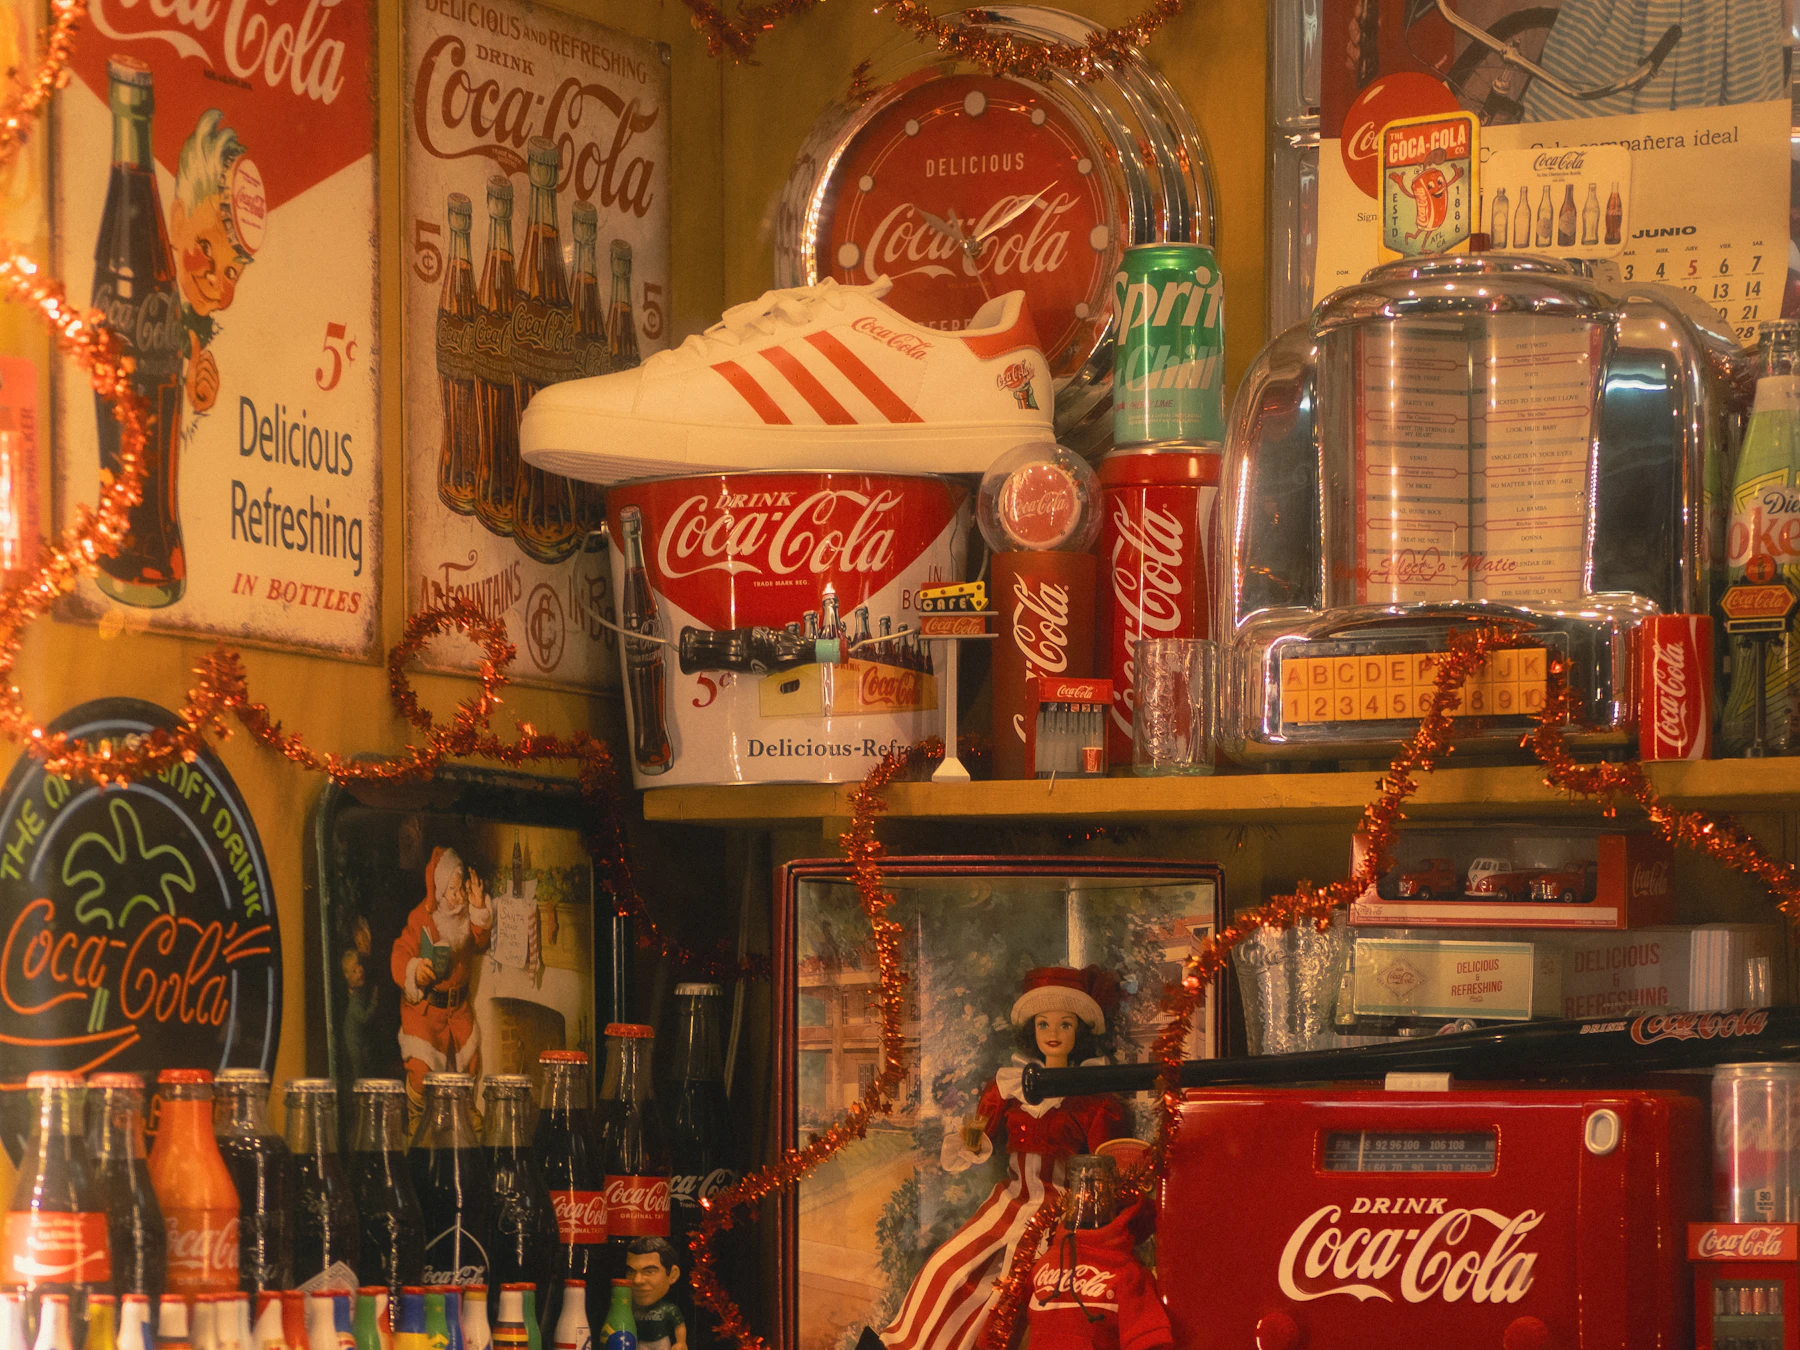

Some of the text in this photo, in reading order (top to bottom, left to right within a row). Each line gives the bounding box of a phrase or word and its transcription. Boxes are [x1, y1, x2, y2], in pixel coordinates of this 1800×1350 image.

[476, 43, 535, 77] DRINK
[523, 29, 547, 46] AND
[549, 30, 648, 85] REFRESHING
[1389, 131, 1404, 141] THE
[1389, 124, 1467, 164] COCA-COLA
[1694, 126, 1739, 147] ideal
[926, 152, 1025, 178] DELICIOUS
[1533, 150, 1586, 172] Coca-Cola
[863, 194, 1081, 281] Coca-Cola
[1632, 225, 1697, 240] JUNIO
[1624, 256, 1762, 281] 3 4 5 6 7
[1713, 281, 1761, 299] 13 14
[1741, 305, 1759, 321] 21
[850, 315, 931, 361] Coca-Cola
[239, 395, 354, 477] Delicious
[714, 491, 799, 509] DRINK
[231, 479, 363, 577] Refreshing
[658, 489, 905, 579] Coca-Cola
[231, 572, 362, 615] IN BOTTLES
[925, 616, 982, 635] Coca-Cola
[861, 666, 923, 706] Coca-Cola
[1313, 665, 1327, 685] B
[1338, 663, 1355, 683] C
[1365, 661, 1381, 681] D
[1391, 660, 1405, 681] E
[1057, 684, 1094, 700] Coca-Cola
[1314, 697, 1327, 716] 2
[1340, 696, 1351, 716] 3
[1365, 694, 1378, 714] 4
[1392, 694, 1405, 714] 5
[1655, 640, 1684, 751] Coca-Cola
[0, 799, 46, 881] THE
[212, 809, 263, 918] DRINK
[1, 897, 229, 1028] Coca-Cola
[1456, 958, 1500, 974] DELICIOUS
[1573, 942, 1661, 974] DELICIOUS
[1451, 980, 1503, 997] REFRESHING
[1579, 1006, 1770, 1046] DRINK Coca-Cola
[1350, 1197, 1448, 1215] DRINK
[1278, 1205, 1546, 1304] Coca-Cola
[1698, 1227, 1785, 1258] Coca-Cola
